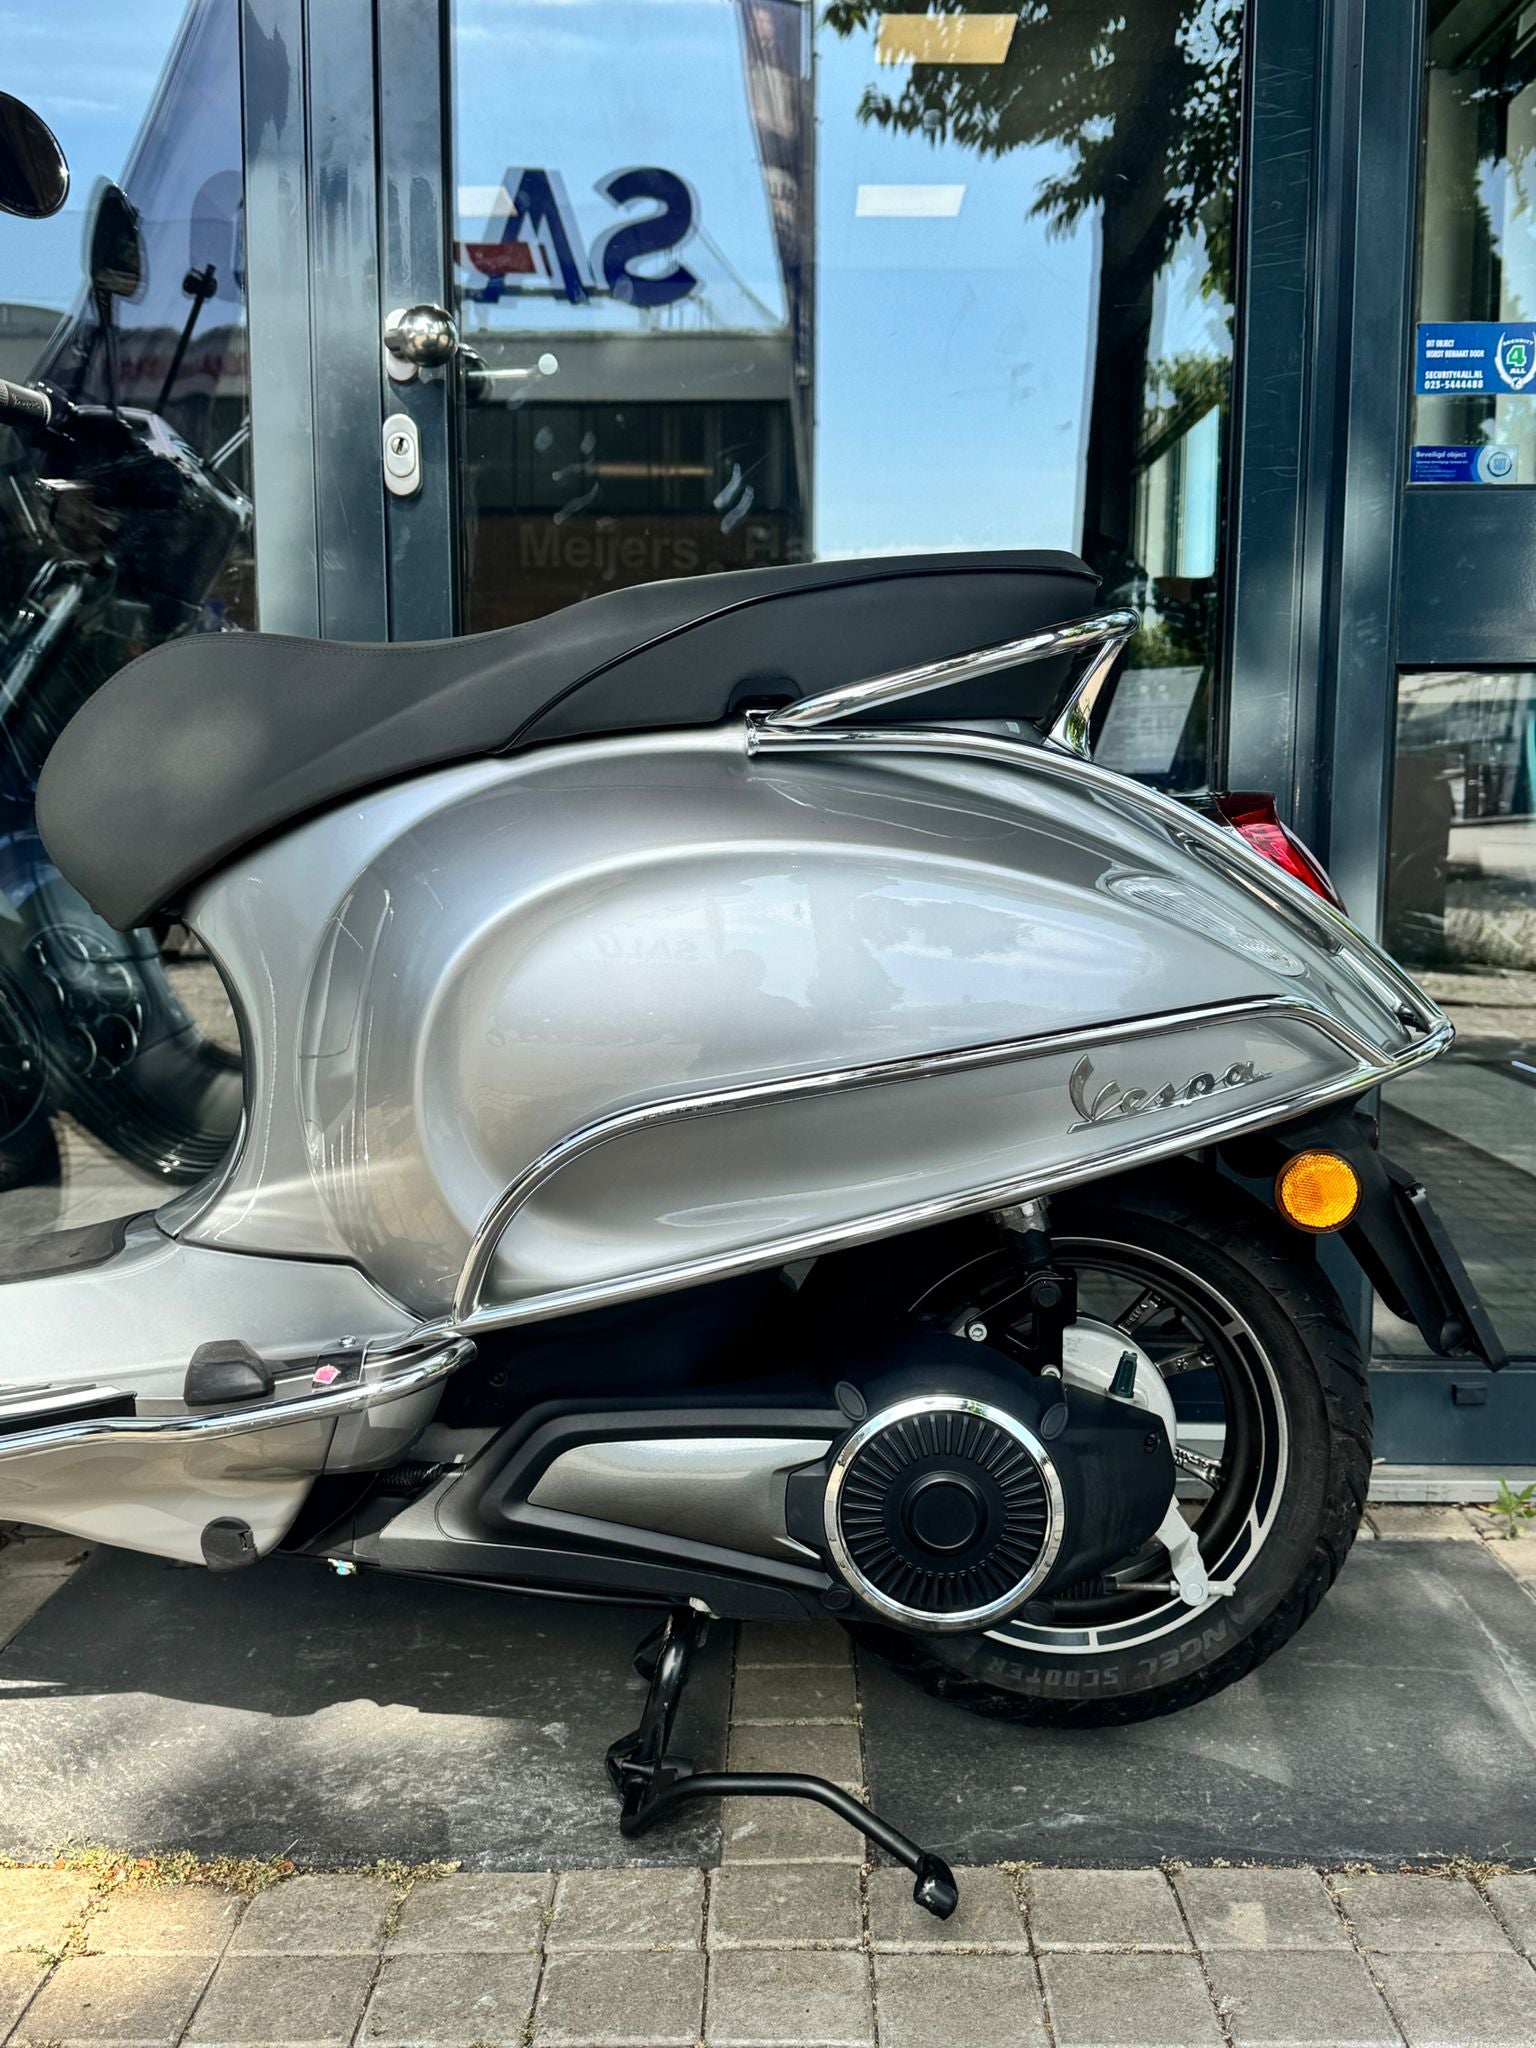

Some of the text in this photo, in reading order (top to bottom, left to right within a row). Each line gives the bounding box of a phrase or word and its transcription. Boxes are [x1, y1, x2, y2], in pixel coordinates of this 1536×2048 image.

[1507, 345, 1527, 367] 4
[1425, 370, 1483, 379] SECURITY4ALL.NL
[1446, 451, 1467, 460] object
[518, 523, 700, 581] Meijers
[1067, 1053, 1273, 1134] Vespa
[986, 1655, 1120, 1688] SCOOTER
